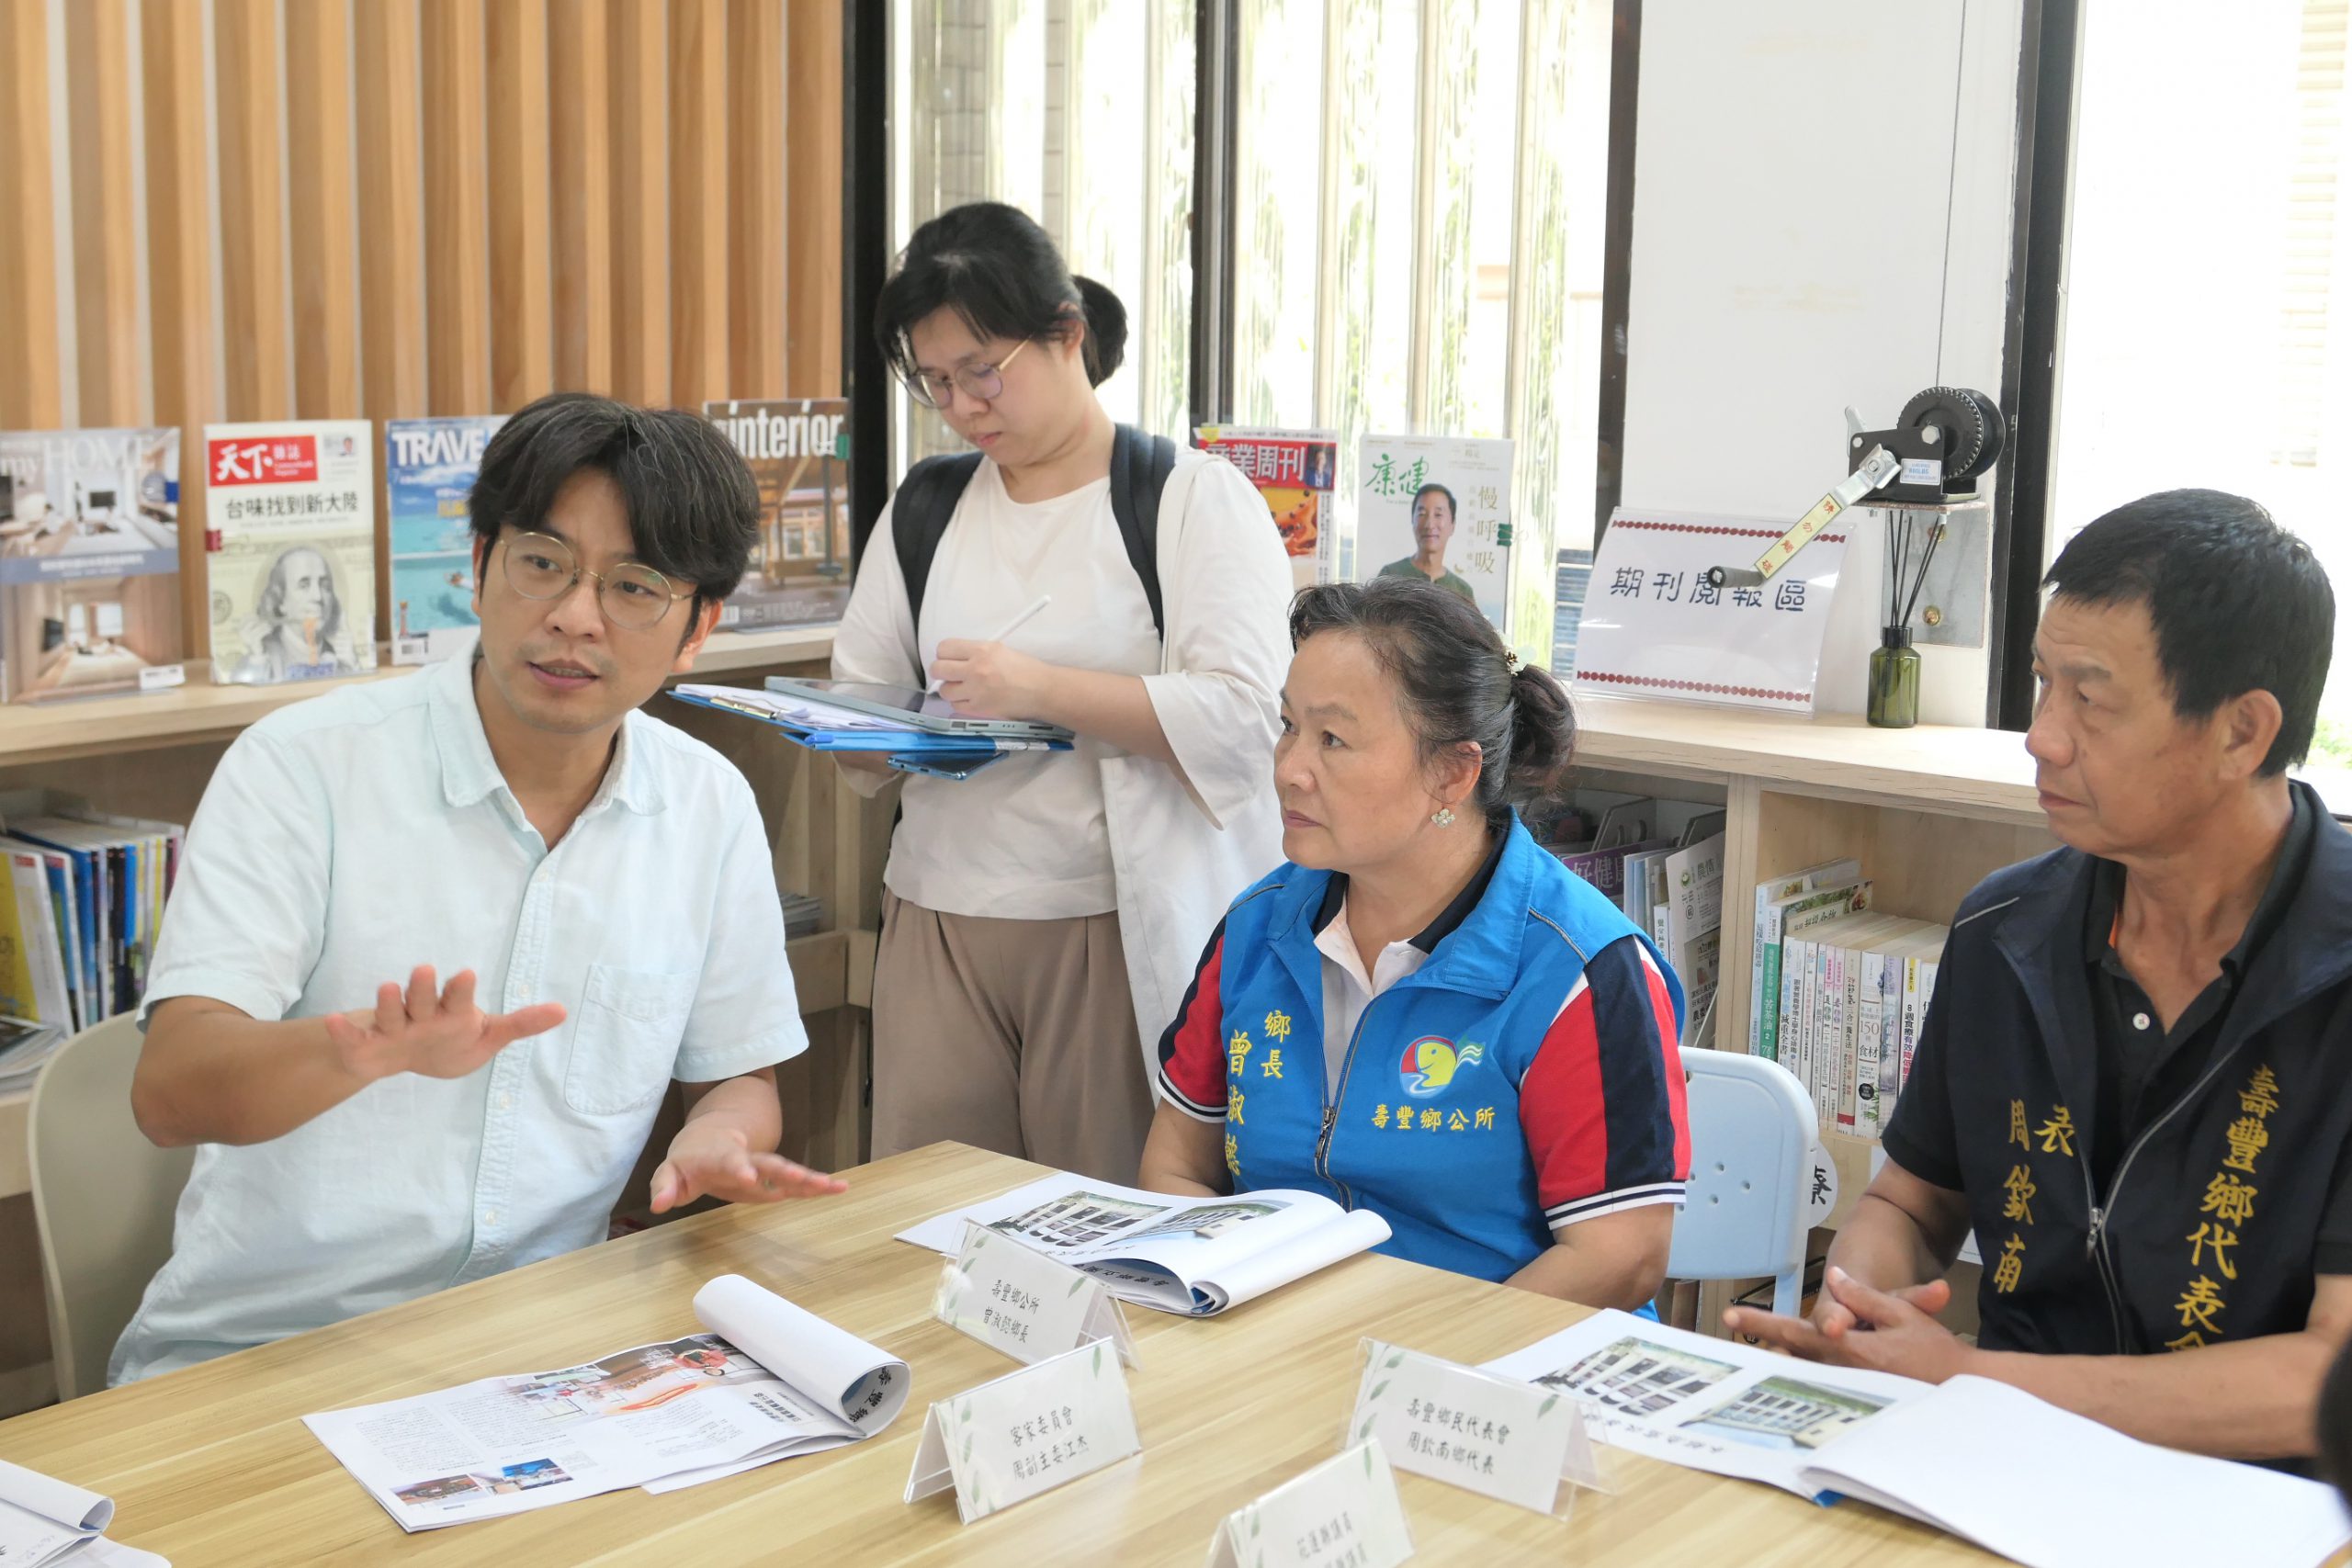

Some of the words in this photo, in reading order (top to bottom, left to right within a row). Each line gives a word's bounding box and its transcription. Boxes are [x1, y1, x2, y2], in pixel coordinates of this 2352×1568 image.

[216, 444, 273, 481] 天下
[226, 491, 359, 520] 台味找到新大陸
[1475, 485, 1499, 574] 慢呼吸
[1261, 1010, 1292, 1079] 鄉長
[1860, 1021, 1880, 1036] 150
[1859, 1044, 1879, 1059] 食材
[1371, 1103, 1496, 1133] 壽豐鄉公所
[1993, 1098, 2037, 1294] 周欽南
[991, 1280, 1041, 1315] 壽豐鄉公所
[1011, 1405, 1072, 1448] 客家委員會
[1407, 1397, 1510, 1446] 壽豐鄉民代表會
[1407, 1430, 1495, 1475] 周欽南鄉代表
